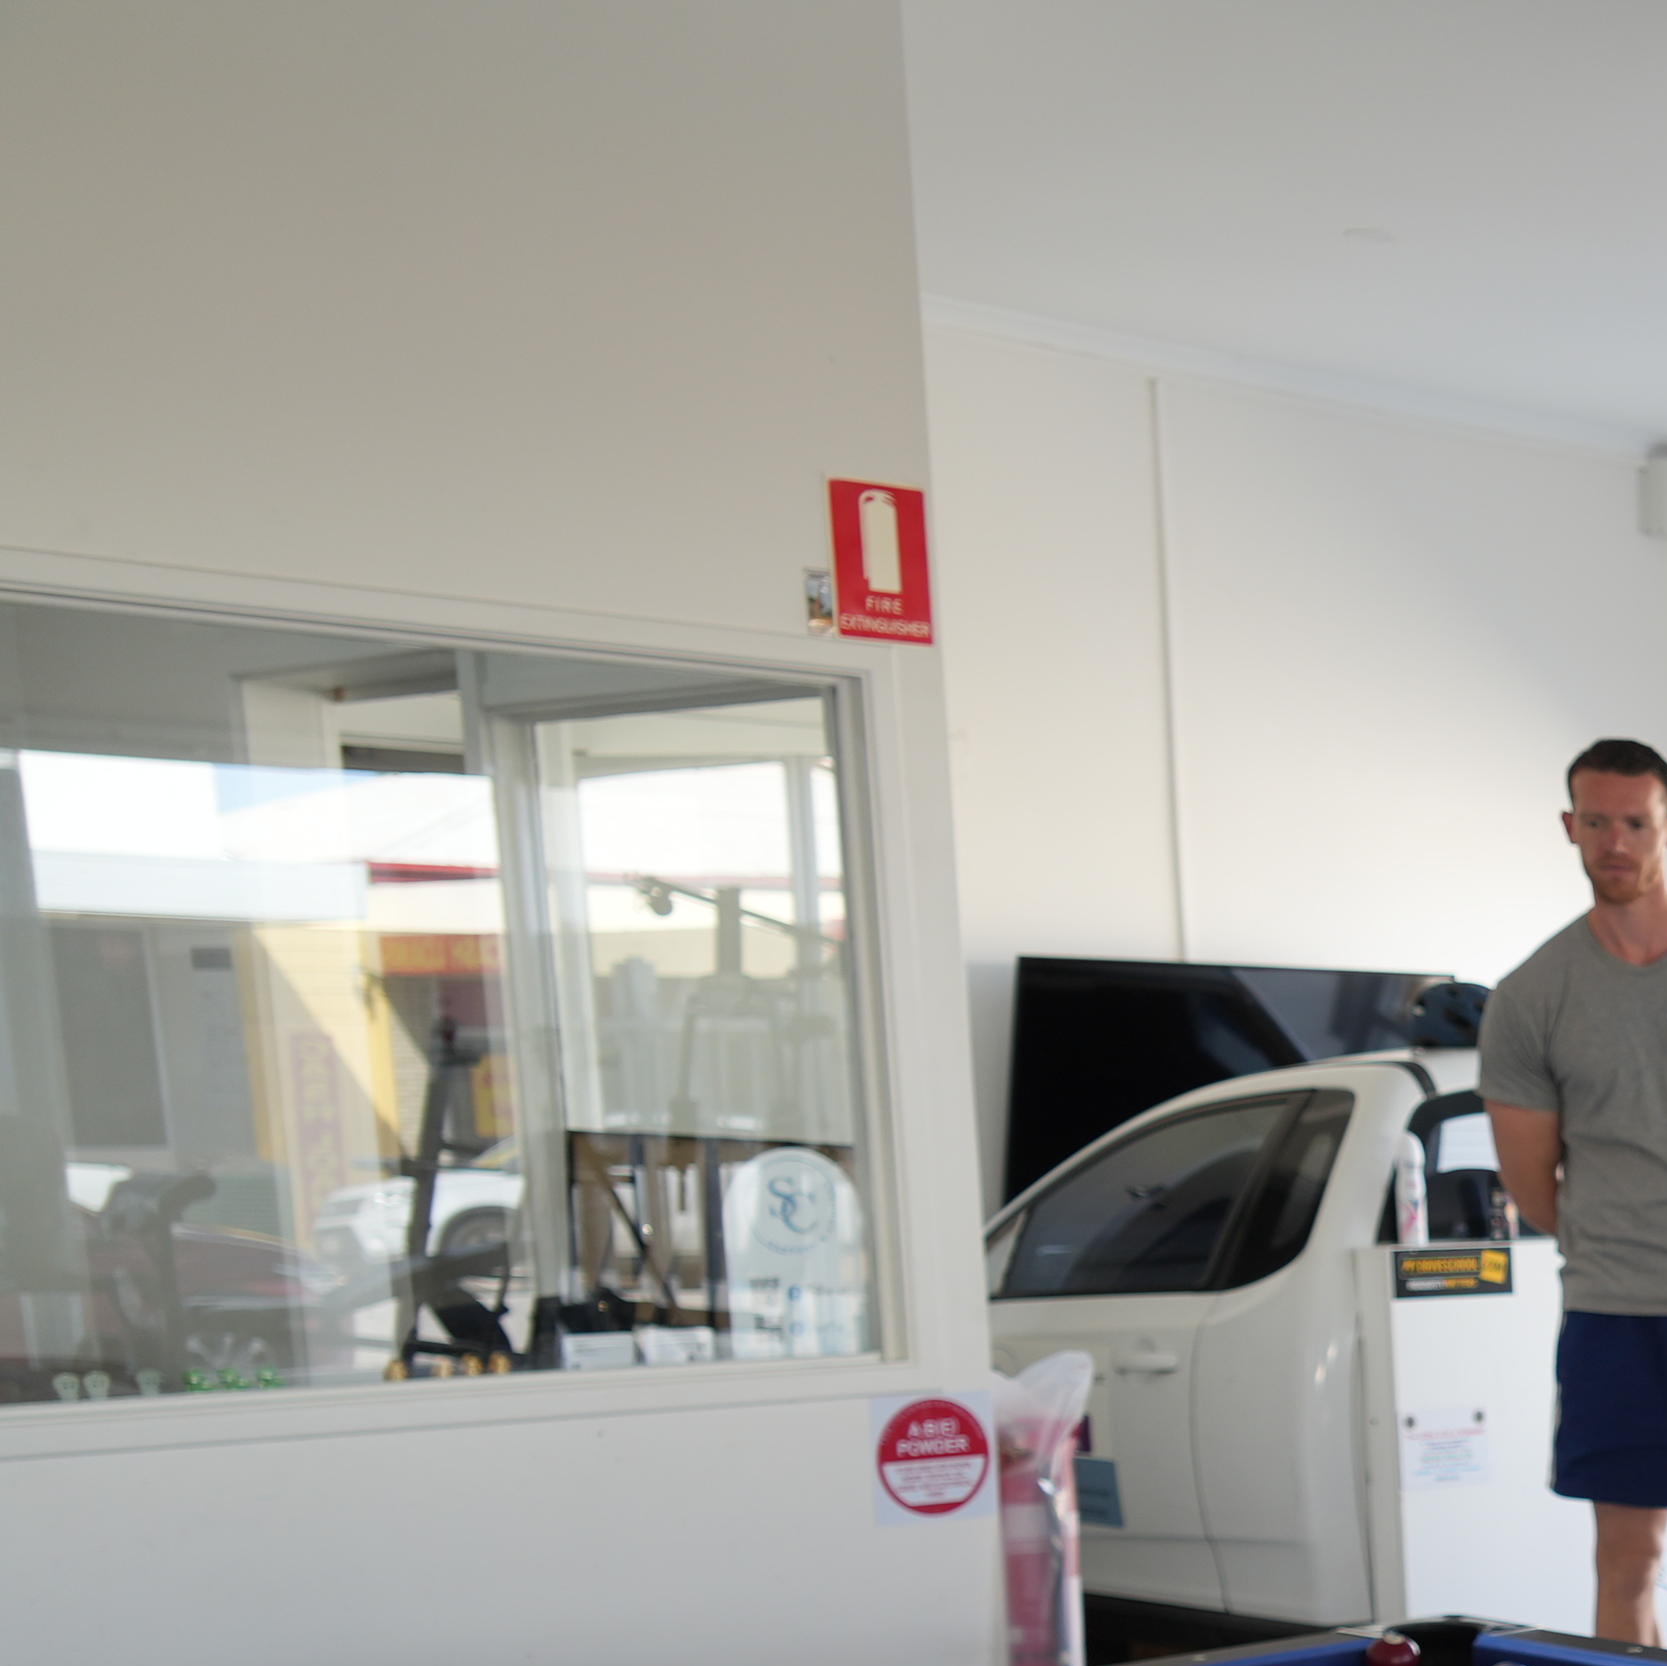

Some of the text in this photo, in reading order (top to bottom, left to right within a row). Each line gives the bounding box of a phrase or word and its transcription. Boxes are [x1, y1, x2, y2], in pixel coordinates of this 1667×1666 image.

[865, 595, 904, 615] FIRE
[840, 613, 930, 637] EXTINGUISHER
[896, 1435, 970, 1457] POWDER
